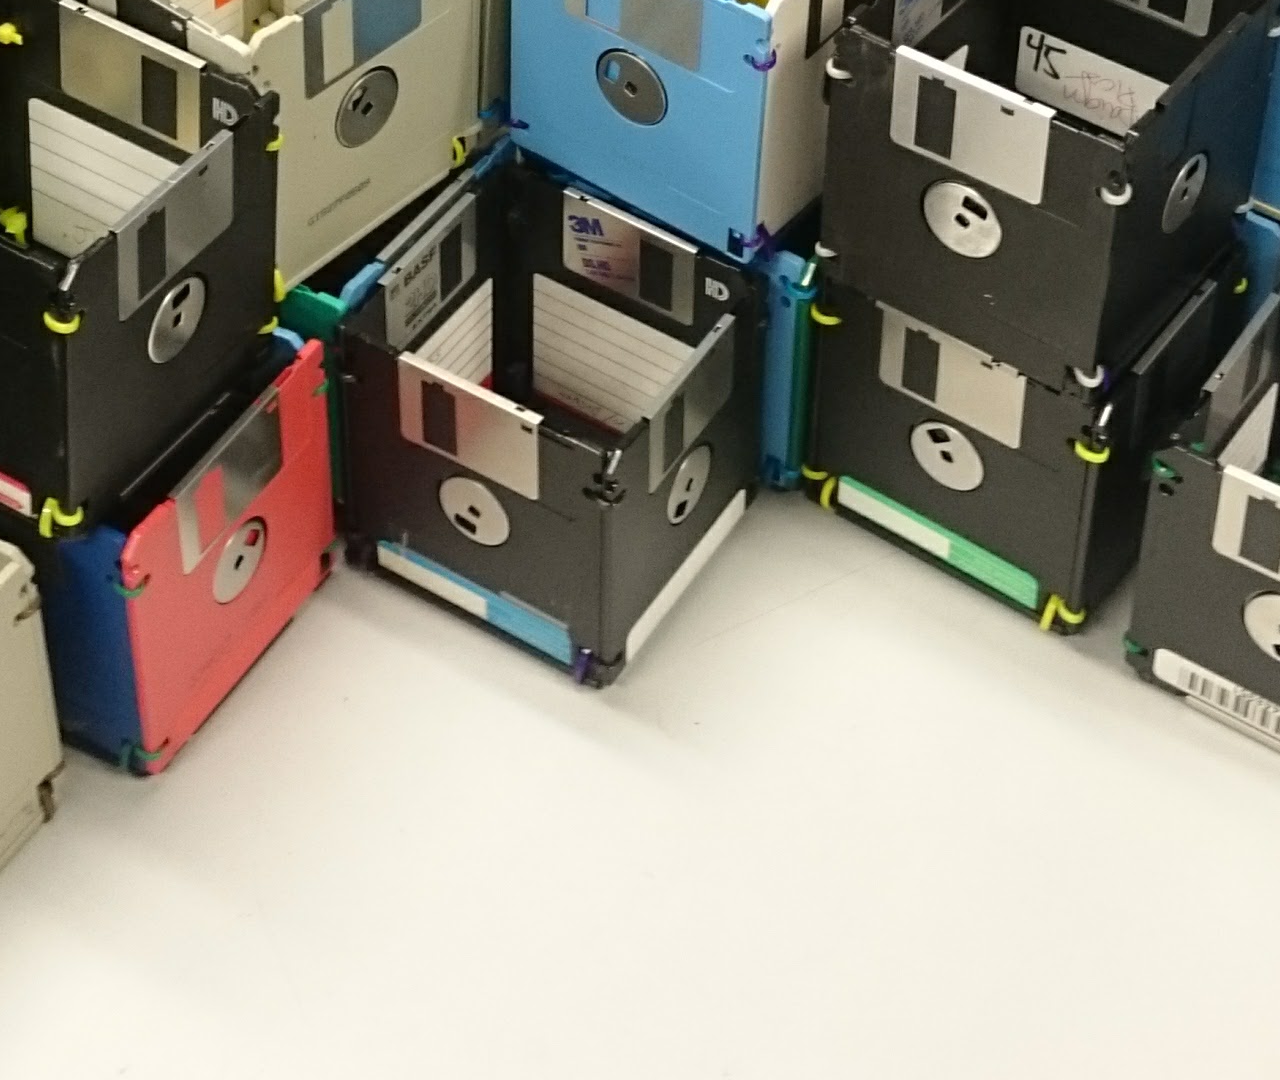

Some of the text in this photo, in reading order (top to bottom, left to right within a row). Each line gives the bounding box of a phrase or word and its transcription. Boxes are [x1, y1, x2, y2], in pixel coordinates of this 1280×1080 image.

[1025, 32, 1067, 80] 45
[212, 97, 240, 126] HD
[567, 215, 605, 237] 3M
[403, 244, 437, 288] BASF
[705, 277, 730, 301] HD
